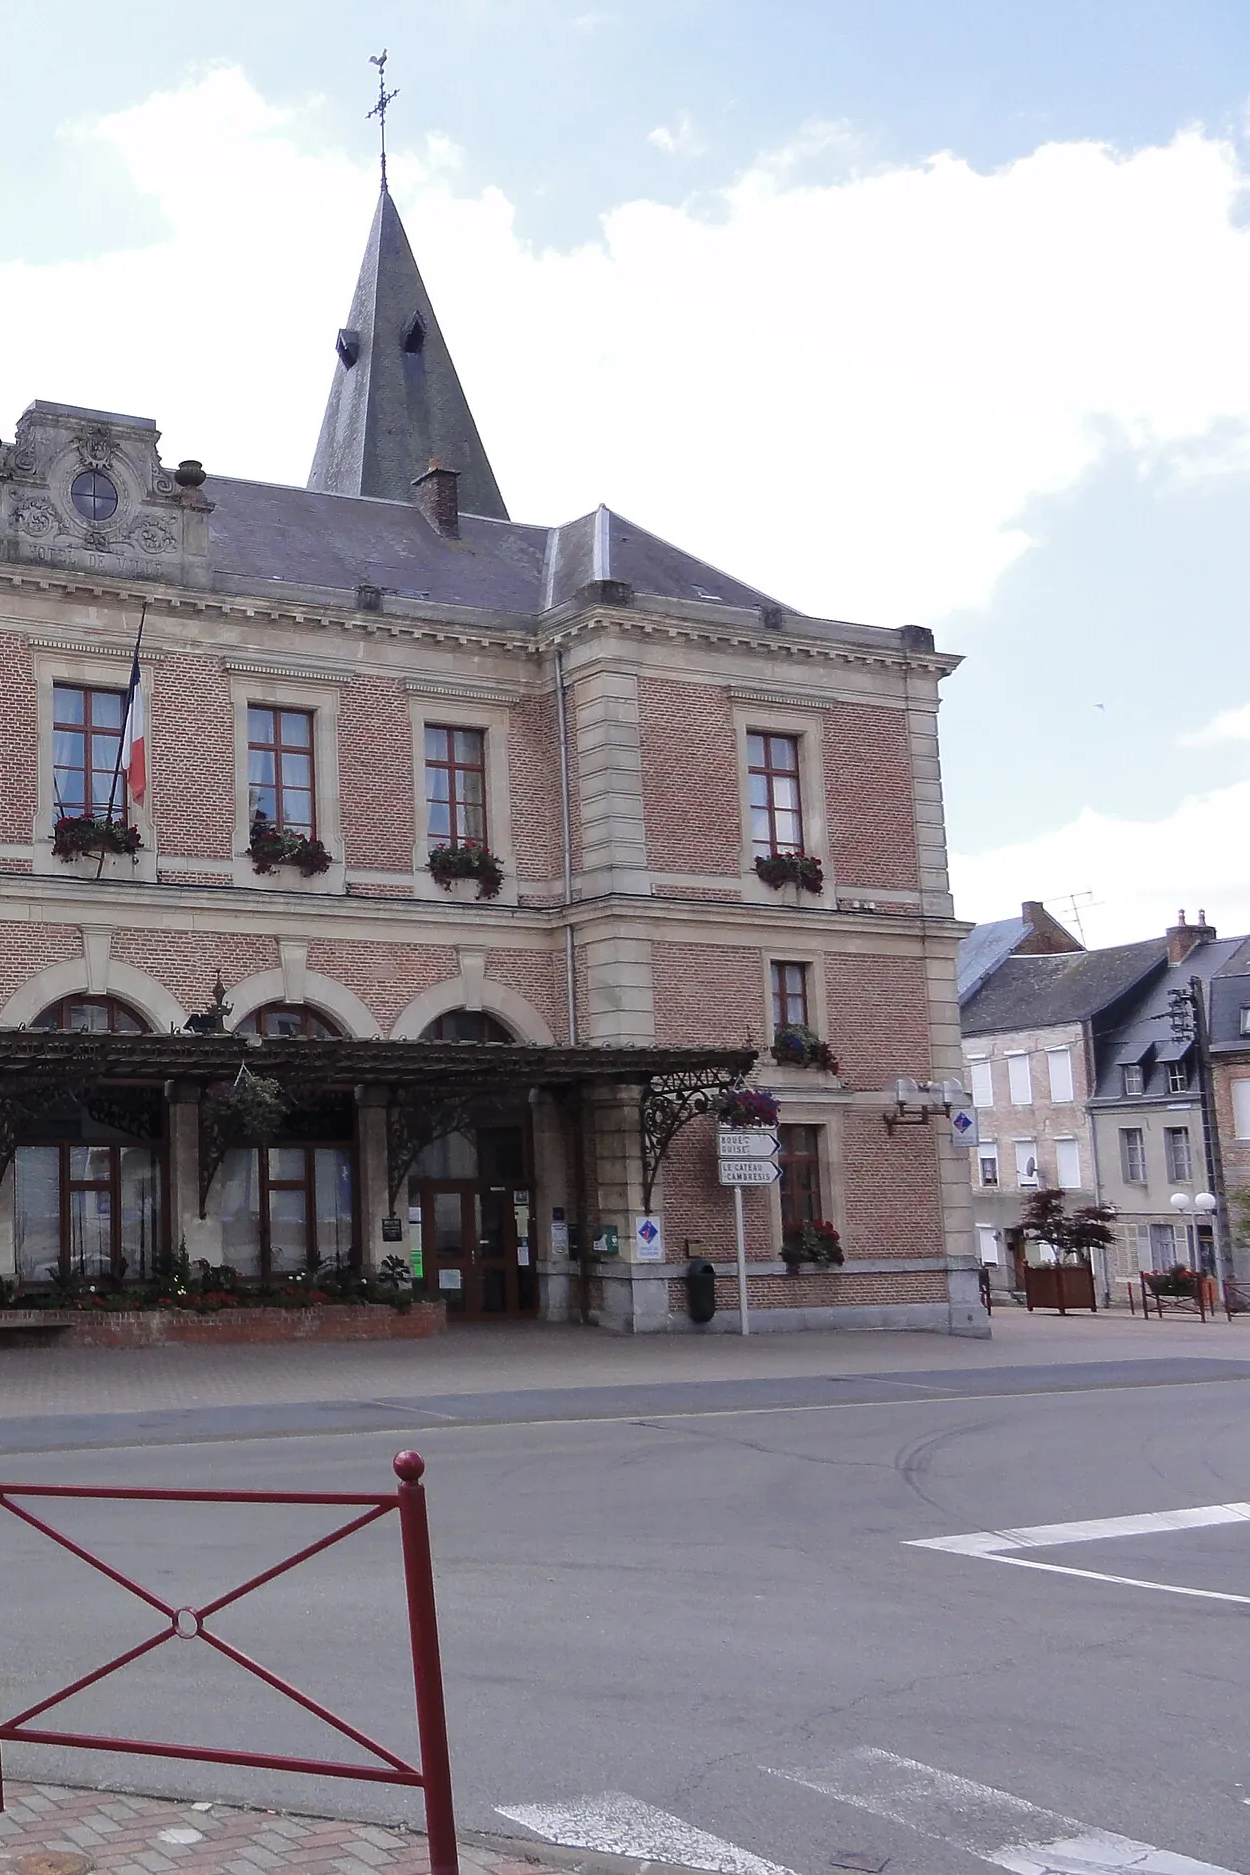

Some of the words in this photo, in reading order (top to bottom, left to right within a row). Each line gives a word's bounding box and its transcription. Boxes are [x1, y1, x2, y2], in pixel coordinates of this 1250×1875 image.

[89, 554, 105, 568] DE
[722, 1163, 732, 1171] LE
[734, 1163, 763, 1171] CATEAU
